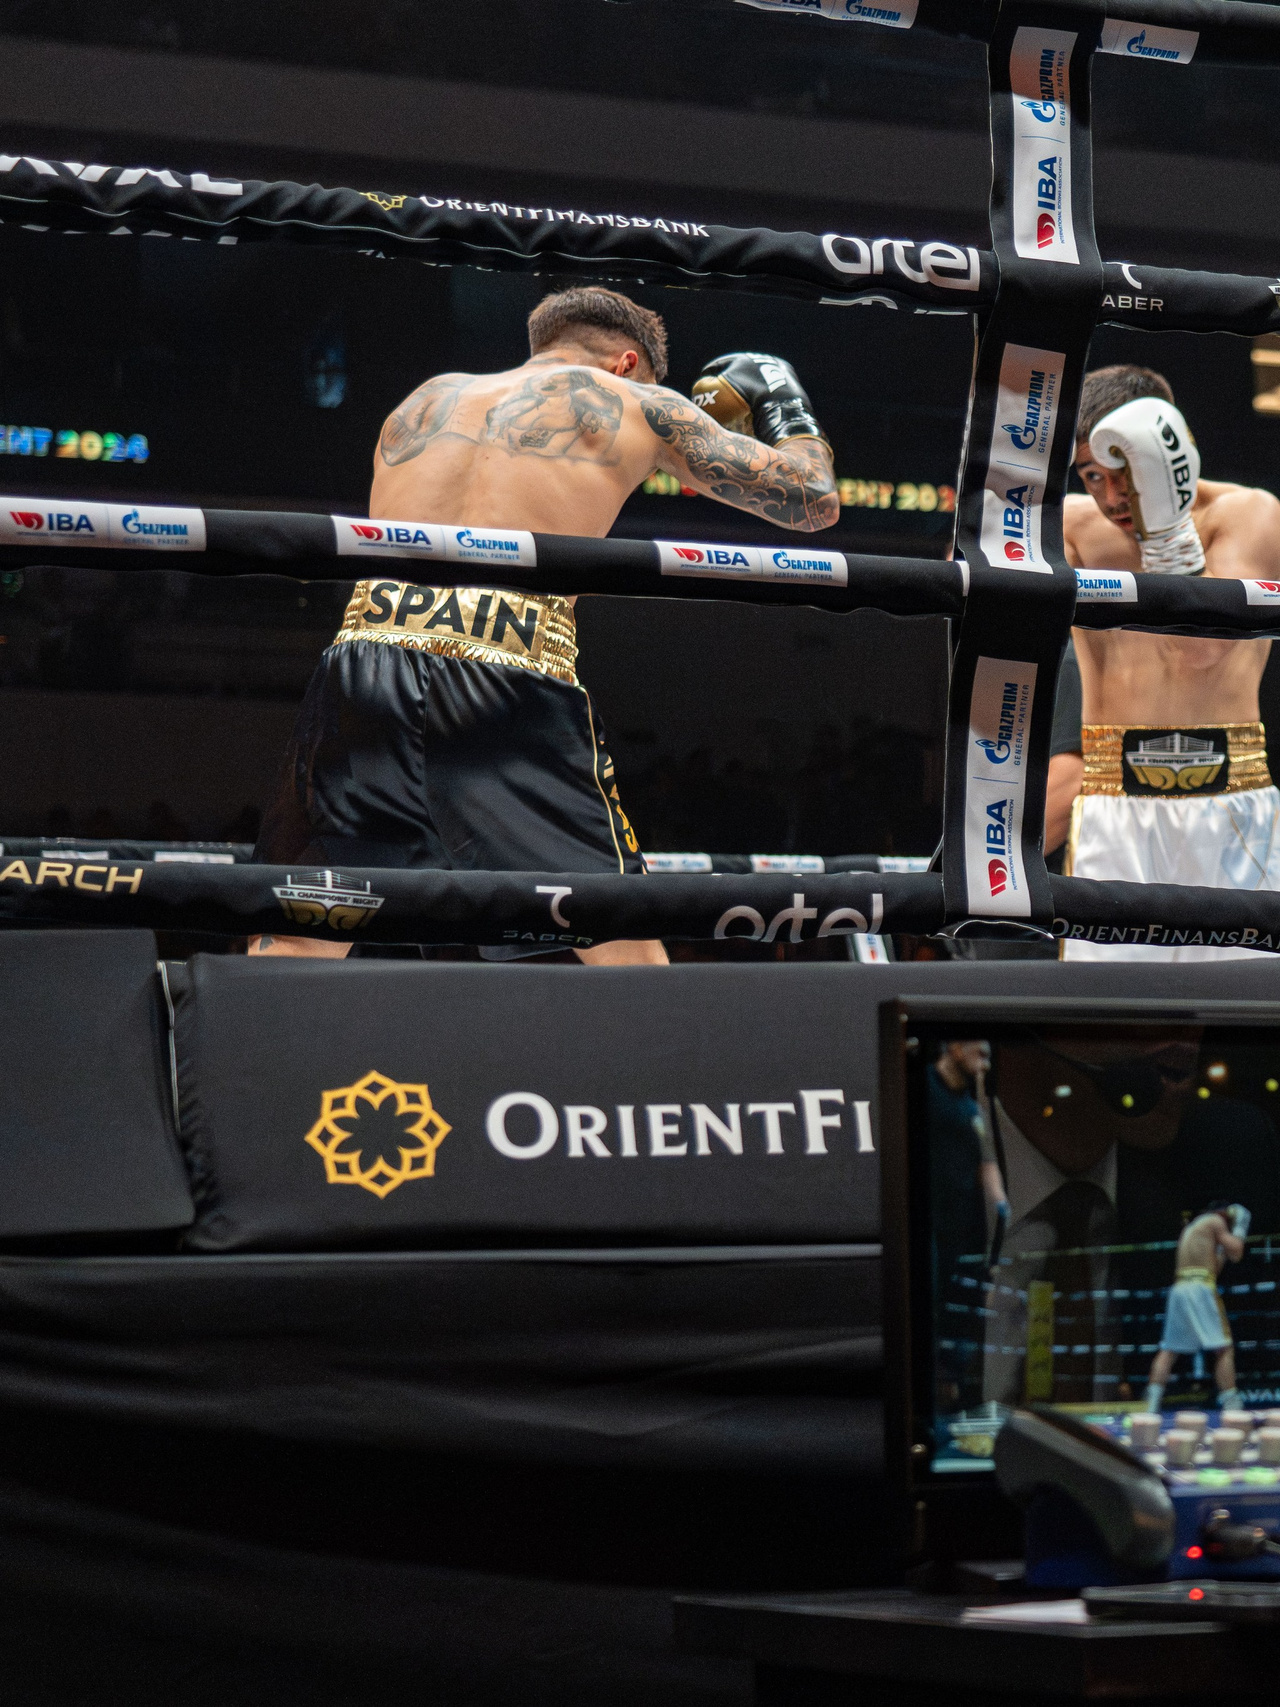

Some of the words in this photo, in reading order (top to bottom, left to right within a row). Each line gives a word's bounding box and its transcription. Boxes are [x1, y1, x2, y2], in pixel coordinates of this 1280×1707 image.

[1059, 90, 1067, 126] GENERAL
[1037, 156, 1057, 211] IBA
[822, 234, 981, 292] artel
[1038, 414, 1051, 454] GENERAL
[1045, 373, 1057, 412] PARTNER
[55, 429, 150, 464] 2024
[1171, 454, 1193, 511] IBA
[48, 513, 95, 533] IBA
[1003, 485, 1029, 539] IBA
[386, 527, 432, 545] IBA
[706, 549, 750, 567] IBA
[362, 581, 538, 652] SPAIN
[1018, 684, 1029, 723] PARTNER
[1013, 727, 1024, 766] GENERAL
[986, 798, 1007, 856] IBA
[0, 860, 144, 895] ARCH
[484, 1088, 875, 1159] ORIENTFI
